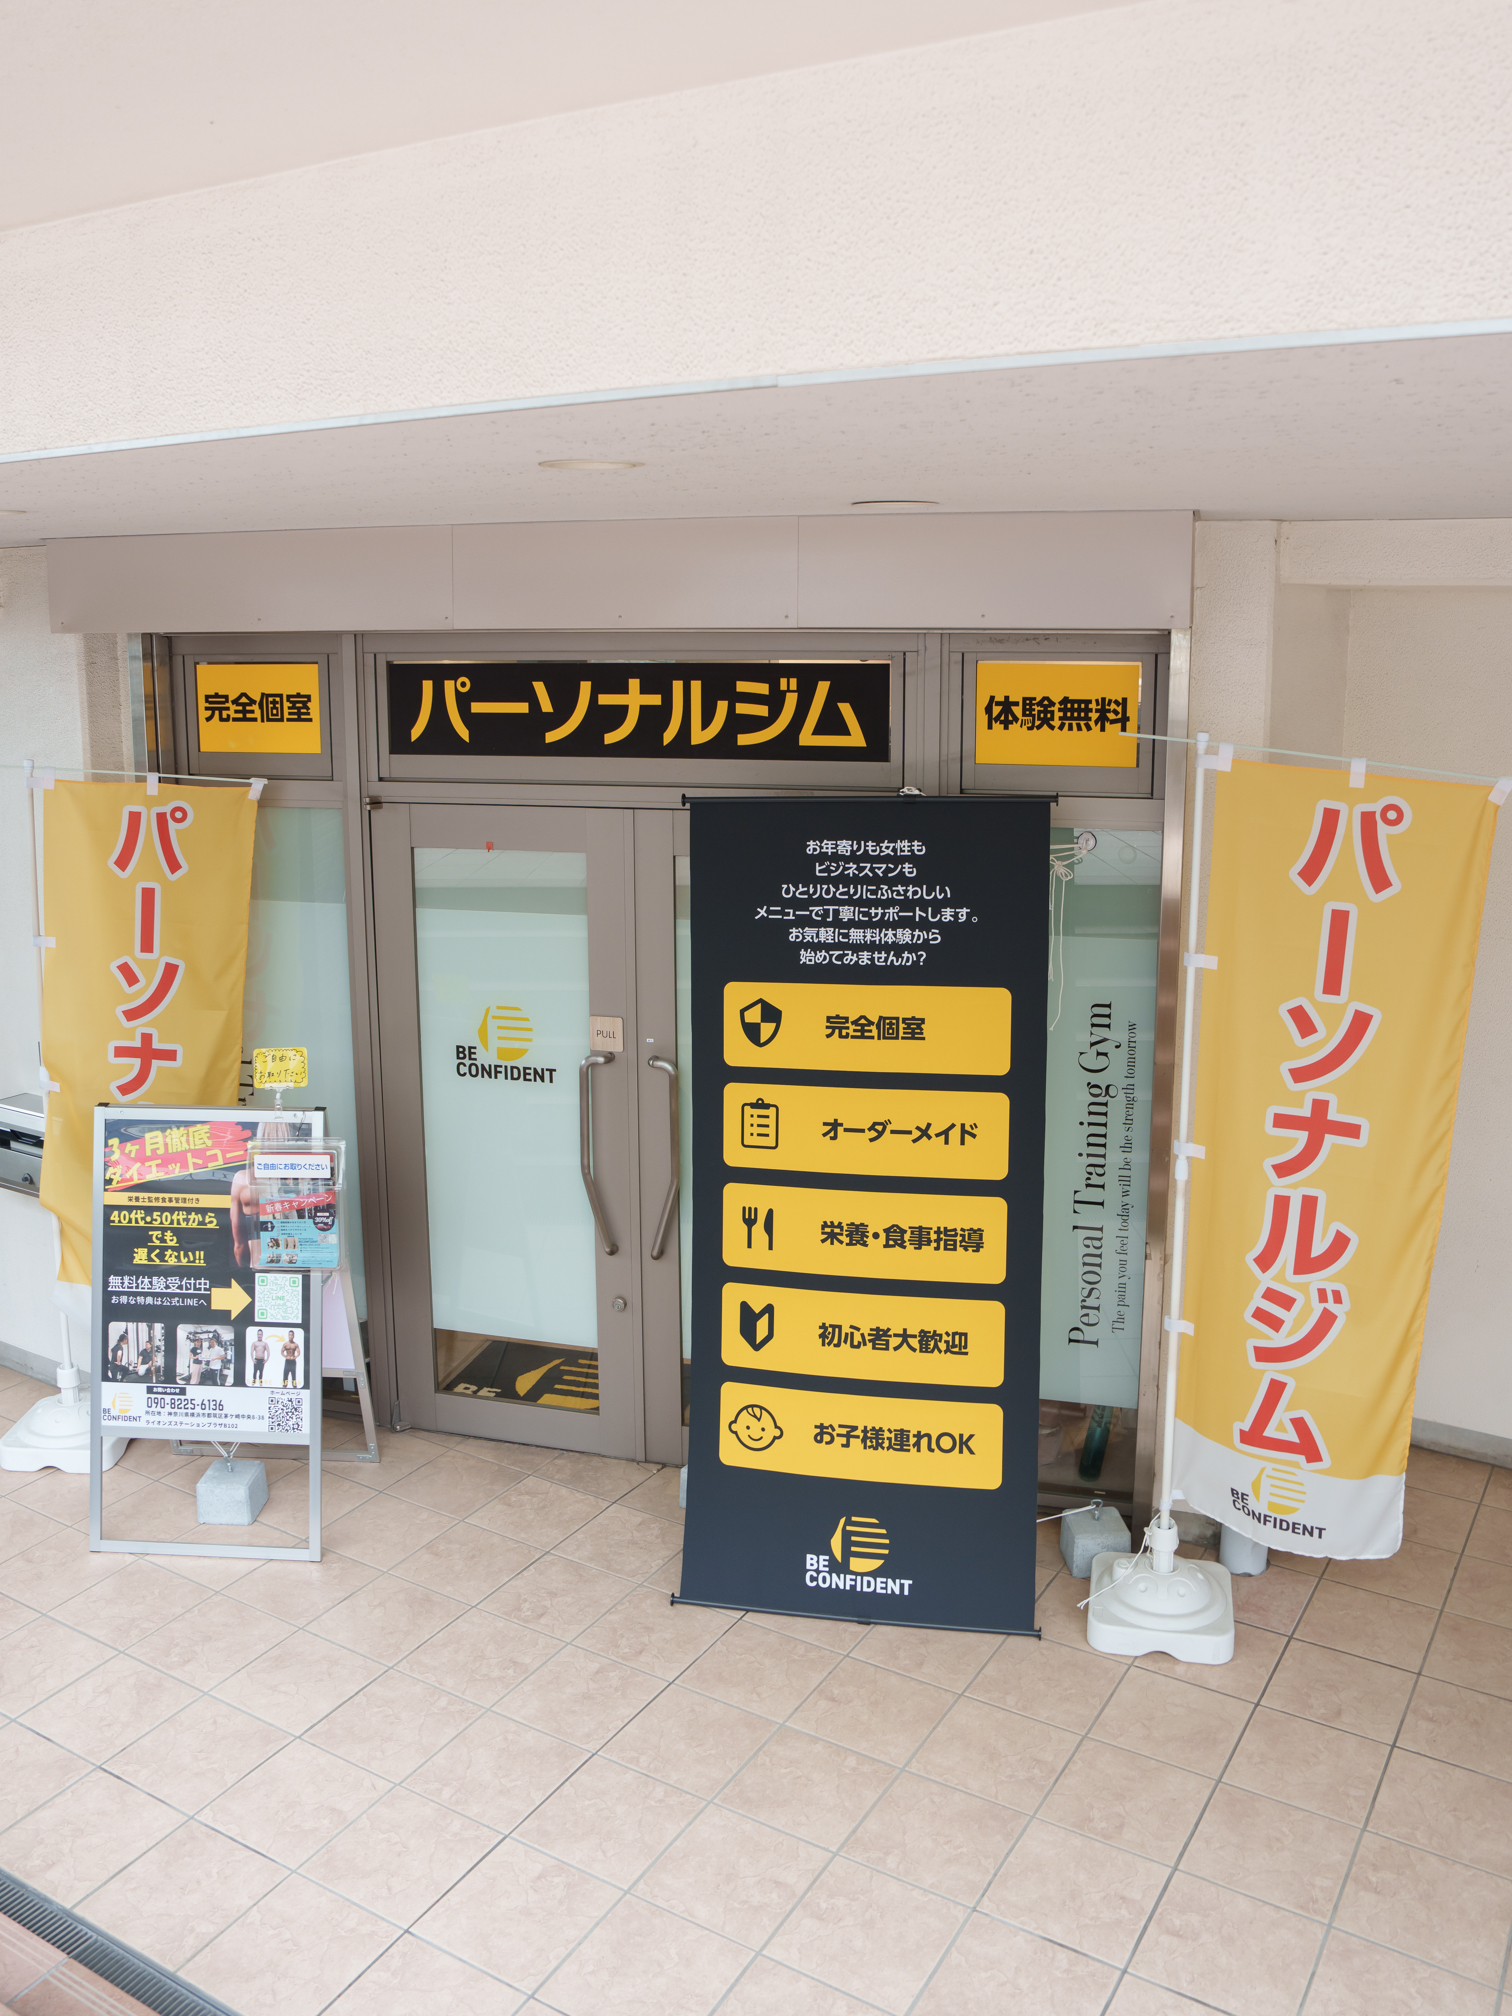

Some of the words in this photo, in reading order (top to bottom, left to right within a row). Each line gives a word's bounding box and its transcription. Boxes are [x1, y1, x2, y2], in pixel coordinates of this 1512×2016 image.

[204, 692, 313, 723] 完全個室
[410, 676, 867, 747] パーソナルジム
[984, 695, 1130, 733] 体験無料
[806, 840, 926, 856] お年寄りも女性も
[815, 861, 917, 878] ビジネスマンも
[781, 884, 951, 900] ひとりひとりにふさわしい
[754, 905, 978, 923] メニューで丁寧にサポートします。
[788, 927, 941, 945] お気軽に無料体験から
[107, 801, 193, 1103] パーソナ
[800, 949, 927, 966] 始めてみませんか？
[596, 1029, 616, 1039] PULL
[825, 1014, 926, 1041] 完全個室
[1078, 1001, 1122, 1074] Gym
[456, 1045, 477, 1061] BE
[1124, 1021, 1137, 1079] tomorrow
[456, 1062, 557, 1084] CONFIDENT
[1122, 1083, 1138, 1133] strength
[107, 1124, 213, 1162] 3ヶ月徹底
[821, 1118, 978, 1146] オーダーメイド
[1231, 801, 1412, 1472] パーソナルジム
[1072, 1082, 1118, 1215] Training
[1119, 1134, 1133, 1154] the
[105, 1142, 262, 1187] ダイエットコー
[256, 1162, 328, 1171] ご自由にお取りください
[1118, 1157, 1132, 1172] be
[1118, 1174, 1132, 1198] will
[127, 1195, 201, 1205] 栄養士監修食事管理付き
[265, 1193, 333, 1214] 新春キャンペーン
[110, 1210, 218, 1227] 40代・50代から
[1117, 1200, 1134, 1232] today
[148, 1230, 178, 1244] でも
[820, 1220, 985, 1253] 栄養・食事指導
[1115, 1235, 1129, 1257] feel
[133, 1248, 205, 1263] 遅くない!!
[1118, 1259, 1131, 1280] you
[108, 1275, 210, 1291] 無料体験受付中
[1068, 1225, 1104, 1348] Personal
[111, 1296, 207, 1306] お得な特典は公式LINEへ
[1114, 1282, 1130, 1308] pain
[1112, 1310, 1125, 1333] The
[818, 1322, 969, 1356] 初心者大歓迎
[146, 1396, 224, 1412] 090-8225-6136
[269, 1389, 302, 1397] ホームページ
[102, 1414, 142, 1423] CONFIDENT
[813, 1422, 976, 1456] お子様連れOK
[1230, 1487, 1249, 1506] BE
[1232, 1498, 1327, 1540] CONFIDENT
[806, 1553, 830, 1571] BE
[805, 1570, 913, 1596] CONFIDENT
